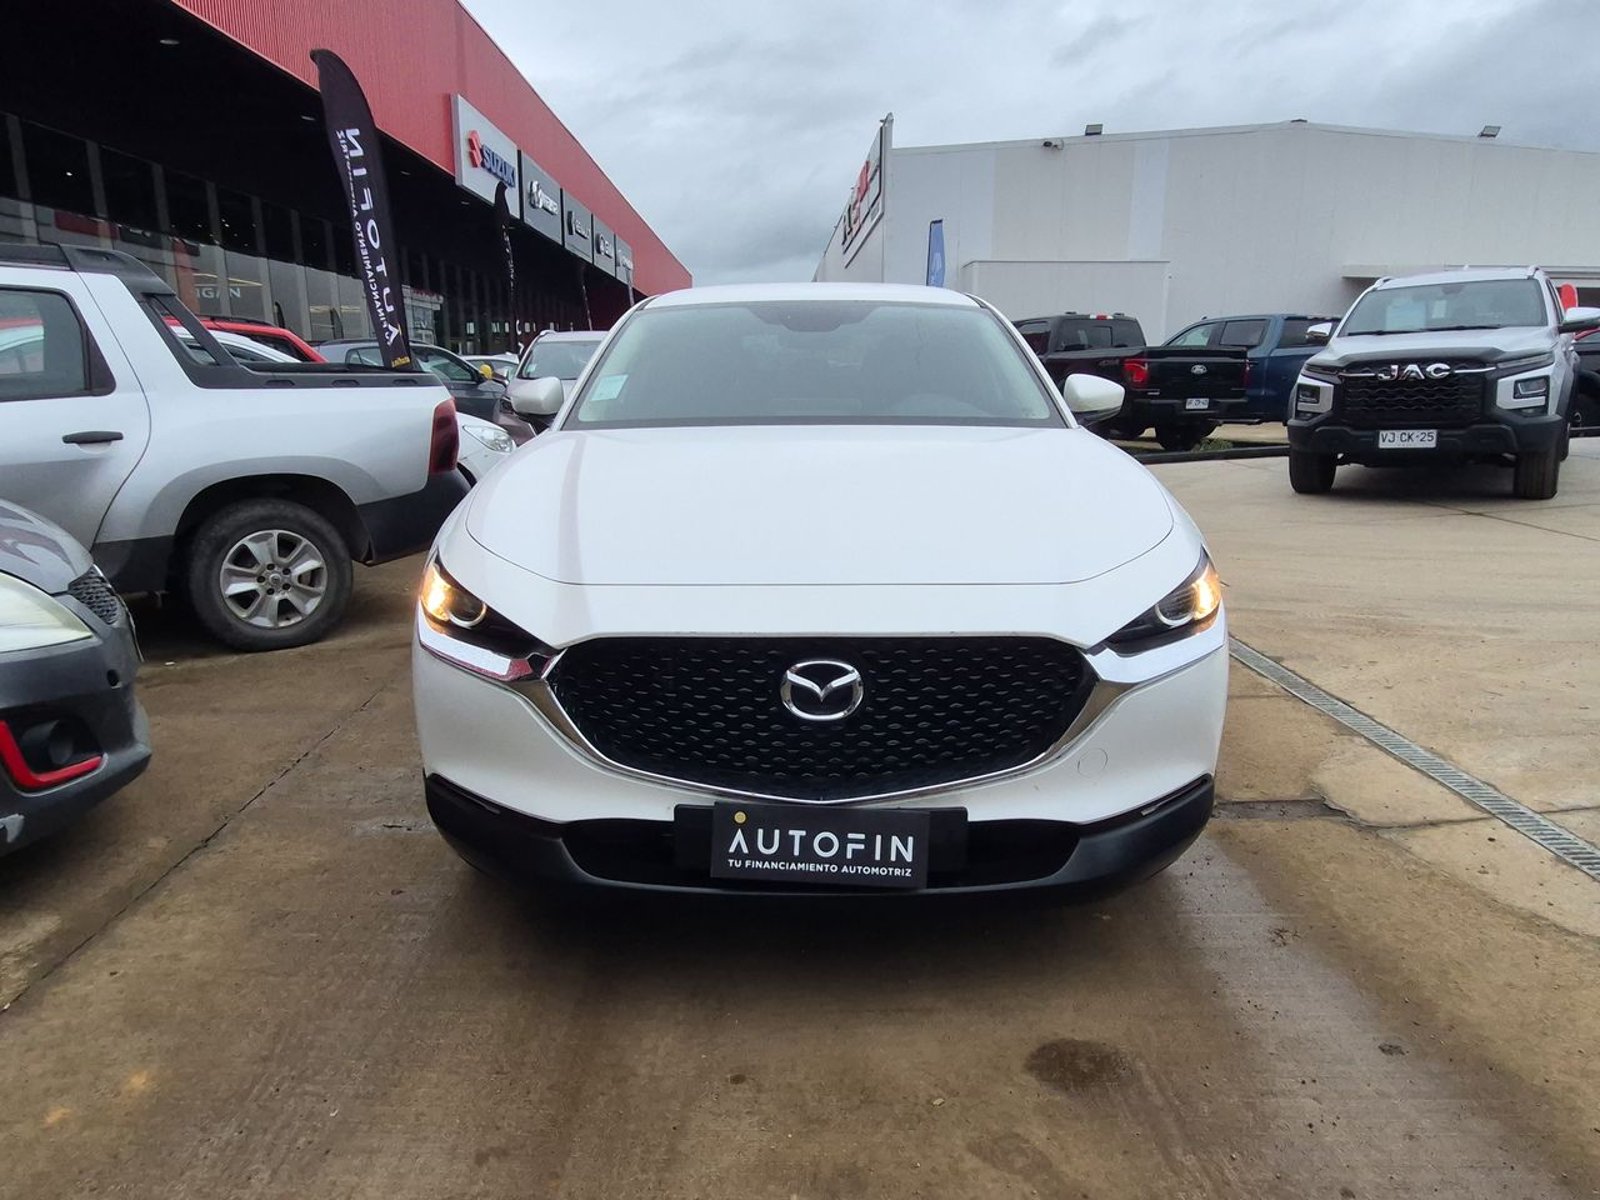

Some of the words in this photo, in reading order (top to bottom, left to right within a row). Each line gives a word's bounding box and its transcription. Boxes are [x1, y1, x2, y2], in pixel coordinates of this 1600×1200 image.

[1378, 363, 1451, 380] JAC
[1381, 432, 1396, 443] VJ
[728, 827, 914, 863] AUTOFIN
[728, 859, 742, 869] TU
[745, 860, 838, 874] FINANCIAMIENTO
[841, 865, 912, 878] AUTOMOTRIZ
